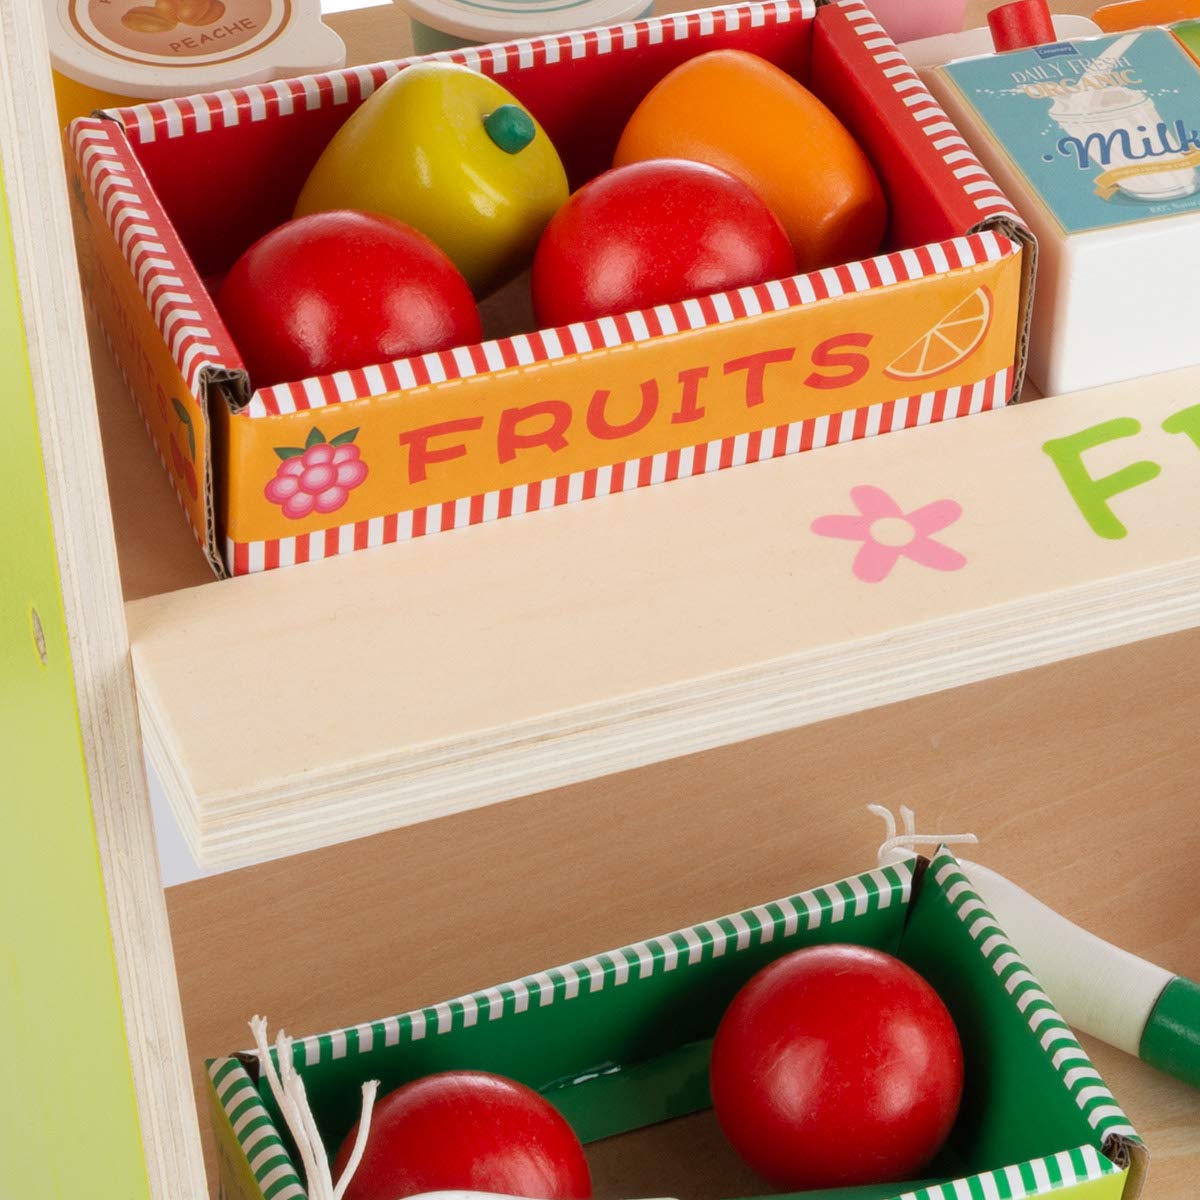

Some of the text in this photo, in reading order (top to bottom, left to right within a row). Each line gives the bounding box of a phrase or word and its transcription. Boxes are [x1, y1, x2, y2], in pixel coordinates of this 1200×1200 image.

[169, 17, 256, 53] PEACHE
[1011, 62, 1064, 83] DAILY
[1024, 69, 1143, 99] ORGANIC
[400, 332, 875, 484] FRUITS
